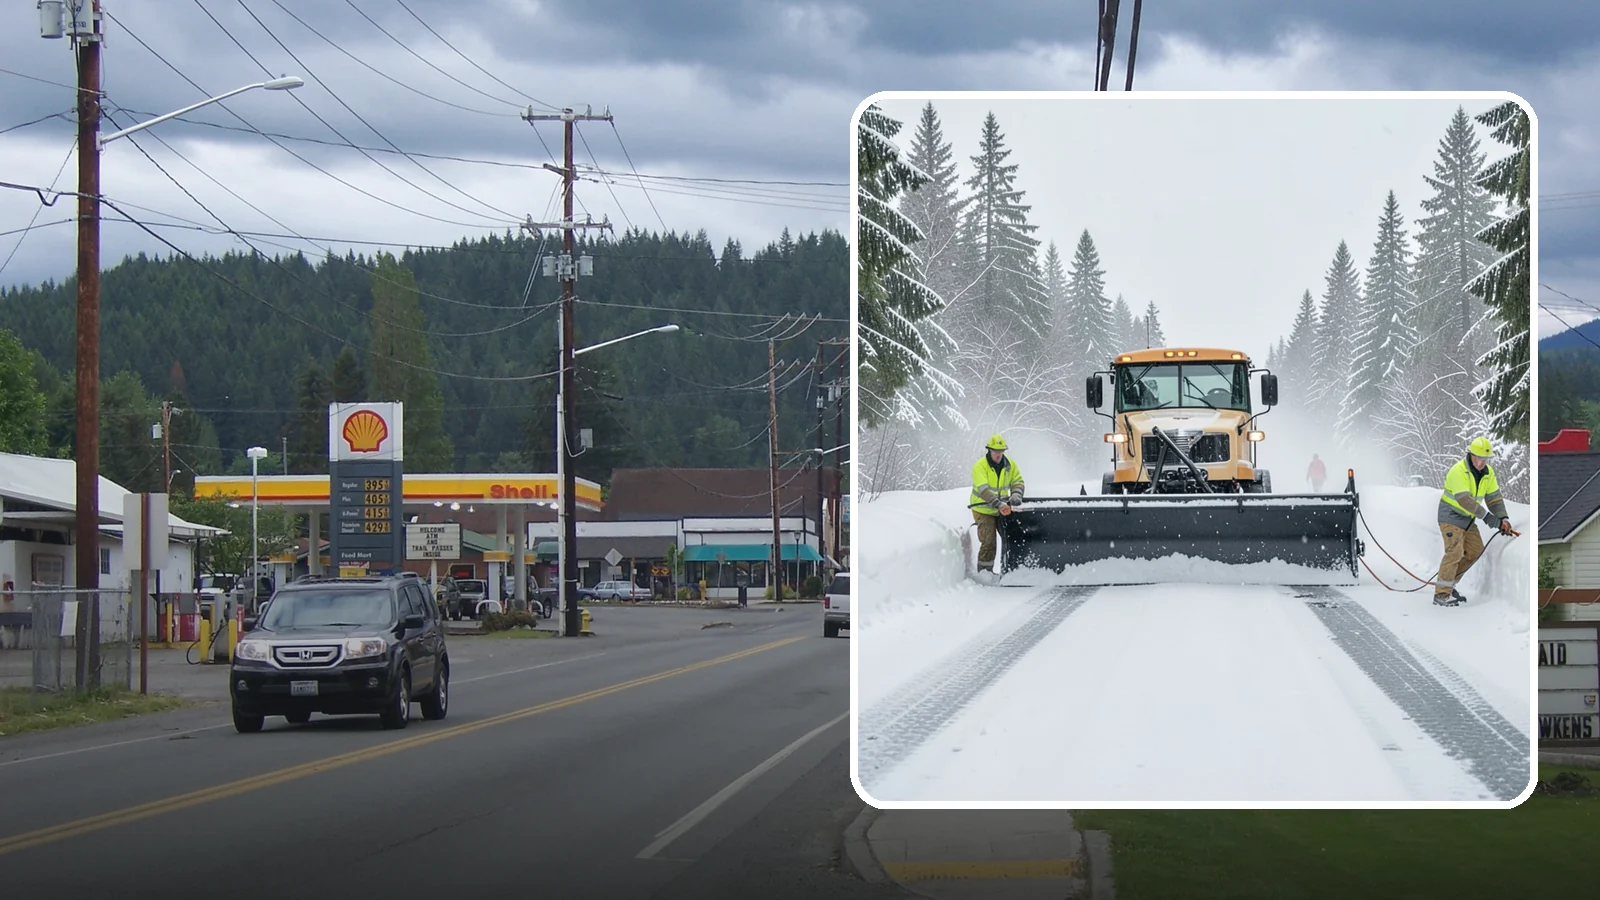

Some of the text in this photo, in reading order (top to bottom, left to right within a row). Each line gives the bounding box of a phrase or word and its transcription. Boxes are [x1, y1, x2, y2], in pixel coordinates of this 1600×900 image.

[365, 480, 384, 490] 395
[490, 484, 547, 499] Shell
[365, 494, 384, 504] 405
[365, 508, 384, 518] 415
[365, 522, 384, 532] 429
[1538, 642, 1567, 665] AID
